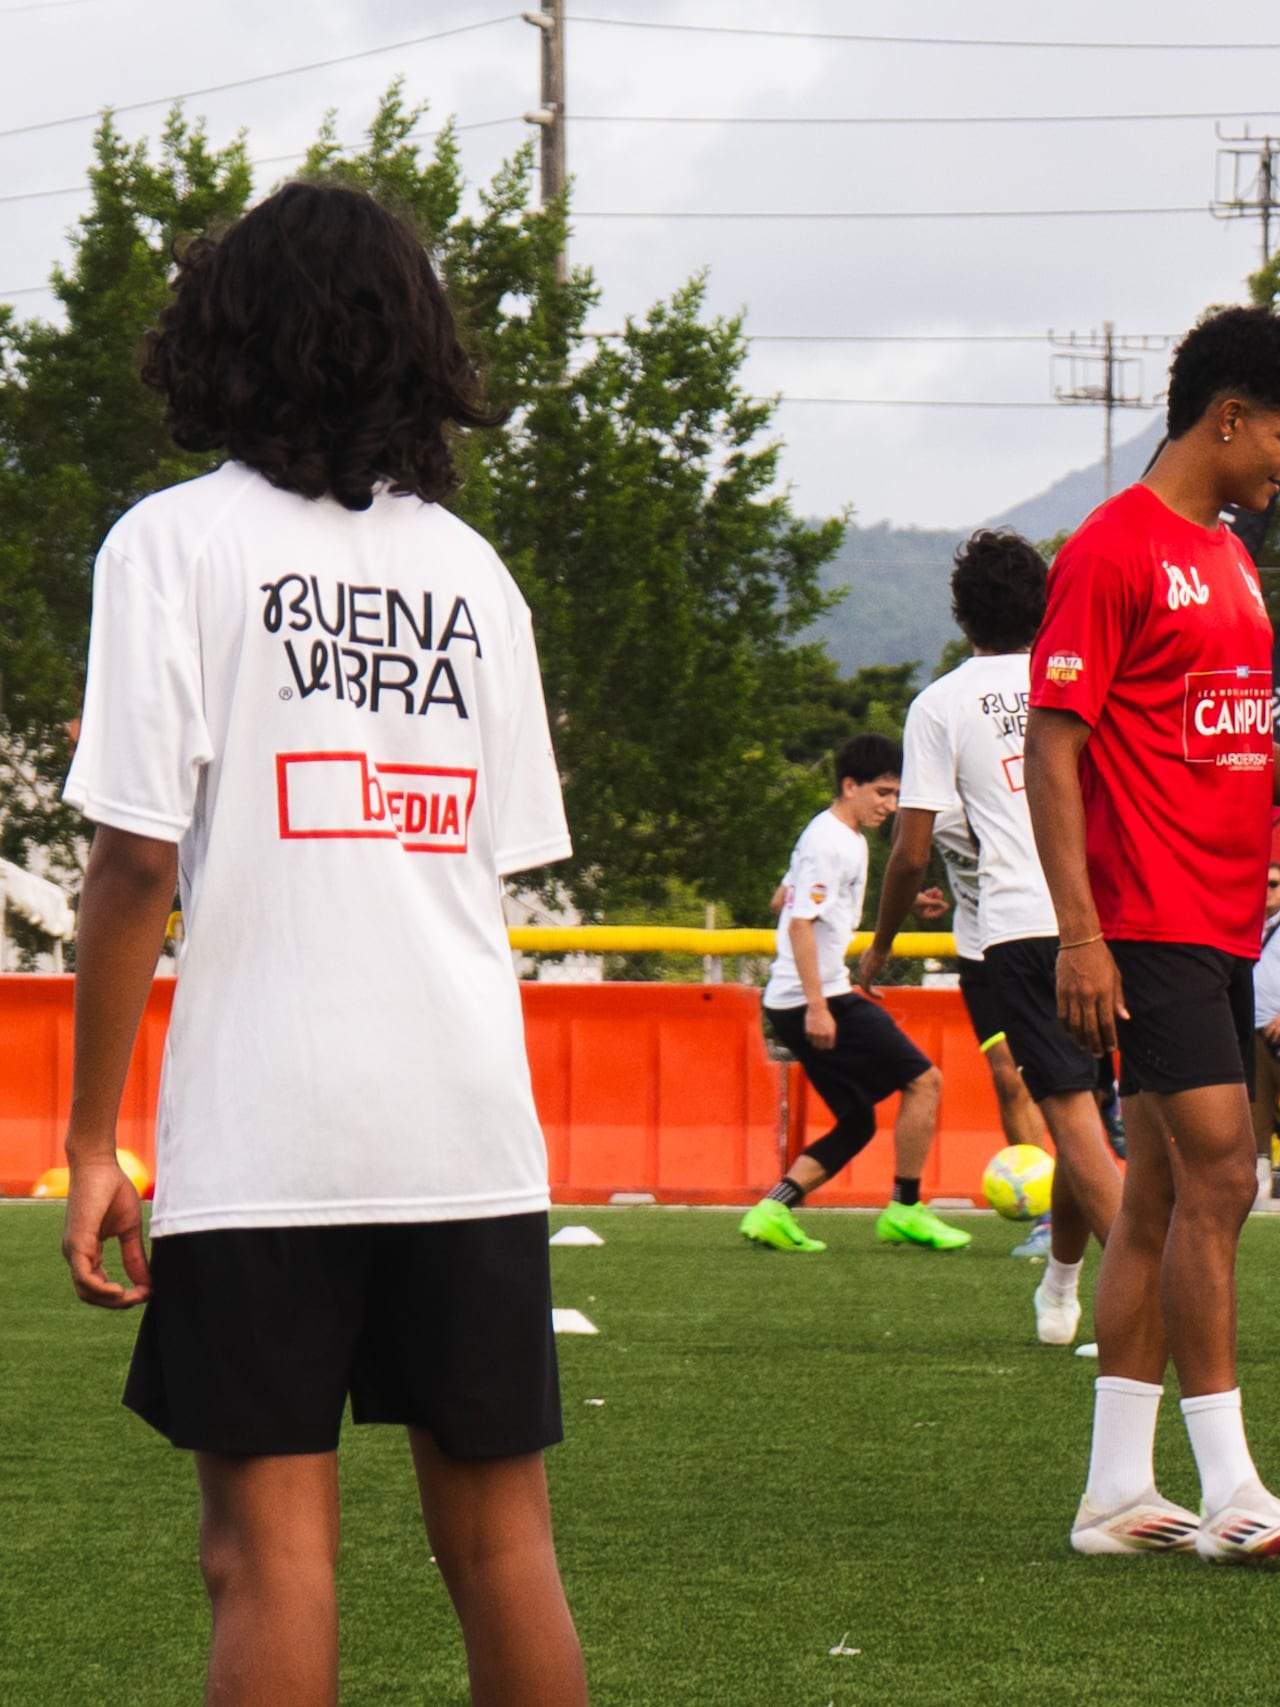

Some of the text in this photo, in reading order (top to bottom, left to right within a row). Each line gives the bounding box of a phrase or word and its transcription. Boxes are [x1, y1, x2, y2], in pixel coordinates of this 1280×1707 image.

[260, 573, 483, 660] BUENA
[978, 691, 1030, 715] BUE
[1194, 698, 1274, 736] CAMPU
